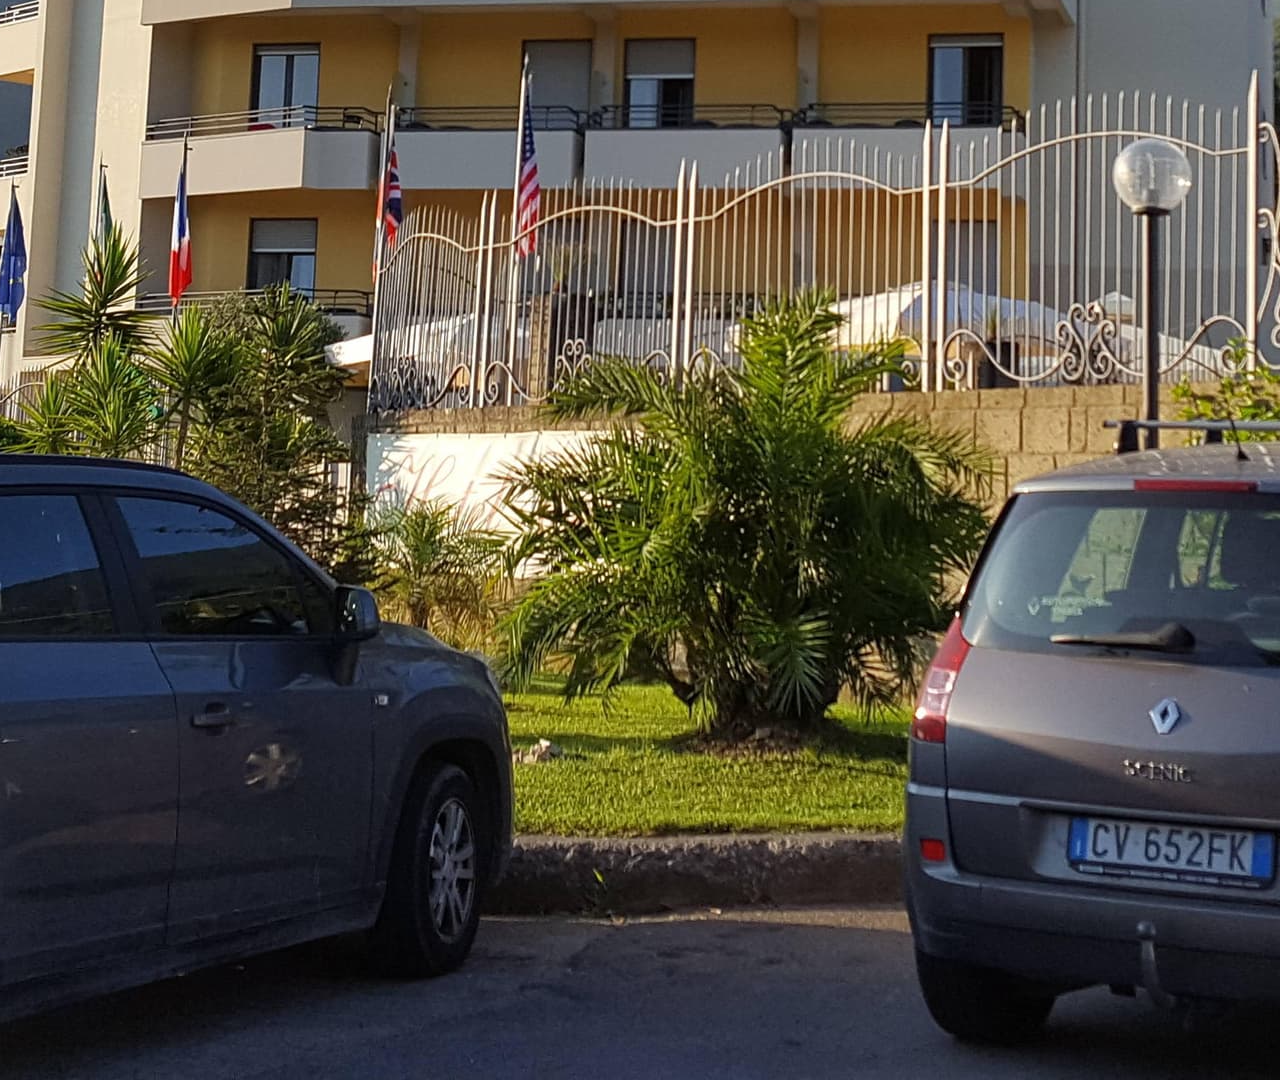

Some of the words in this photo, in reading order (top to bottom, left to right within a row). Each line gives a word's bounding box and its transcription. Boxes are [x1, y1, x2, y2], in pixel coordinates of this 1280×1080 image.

[1123, 759, 1192, 783] SCENIC
[1092, 823, 1131, 860] CV
[1143, 826, 1249, 872] 652FK
